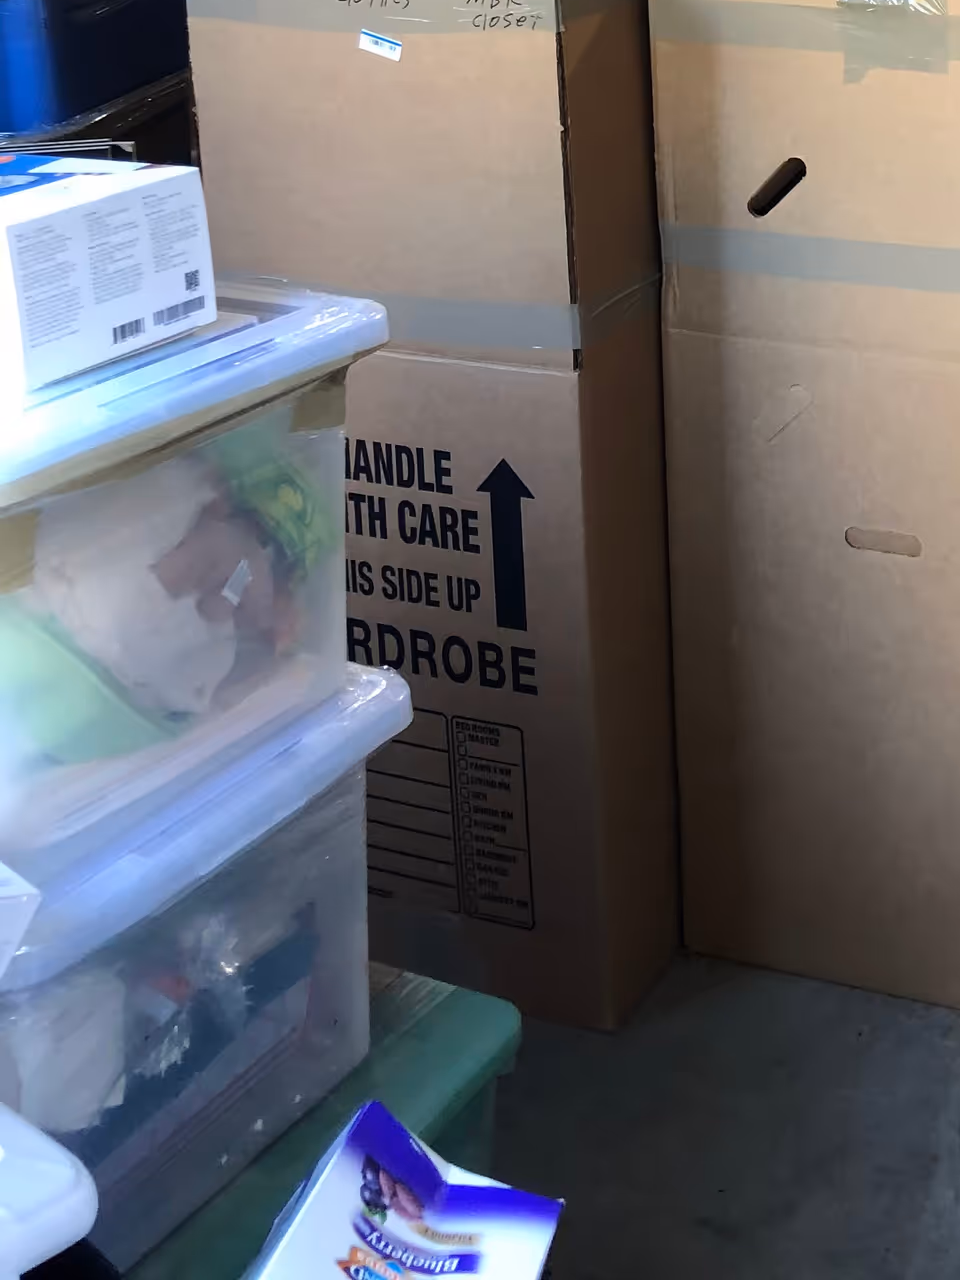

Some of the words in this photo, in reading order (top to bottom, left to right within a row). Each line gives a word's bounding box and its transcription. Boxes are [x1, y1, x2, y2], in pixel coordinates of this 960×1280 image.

[345, 492, 388, 539] ITH
[398, 500, 480, 554] CARE
[345, 559, 374, 596] IS
[381, 565, 440, 608] SIDE
[447, 576, 480, 612] UP
[347, 617, 538, 696] RDROBE
[366, 1231, 460, 1273] Blueberry
